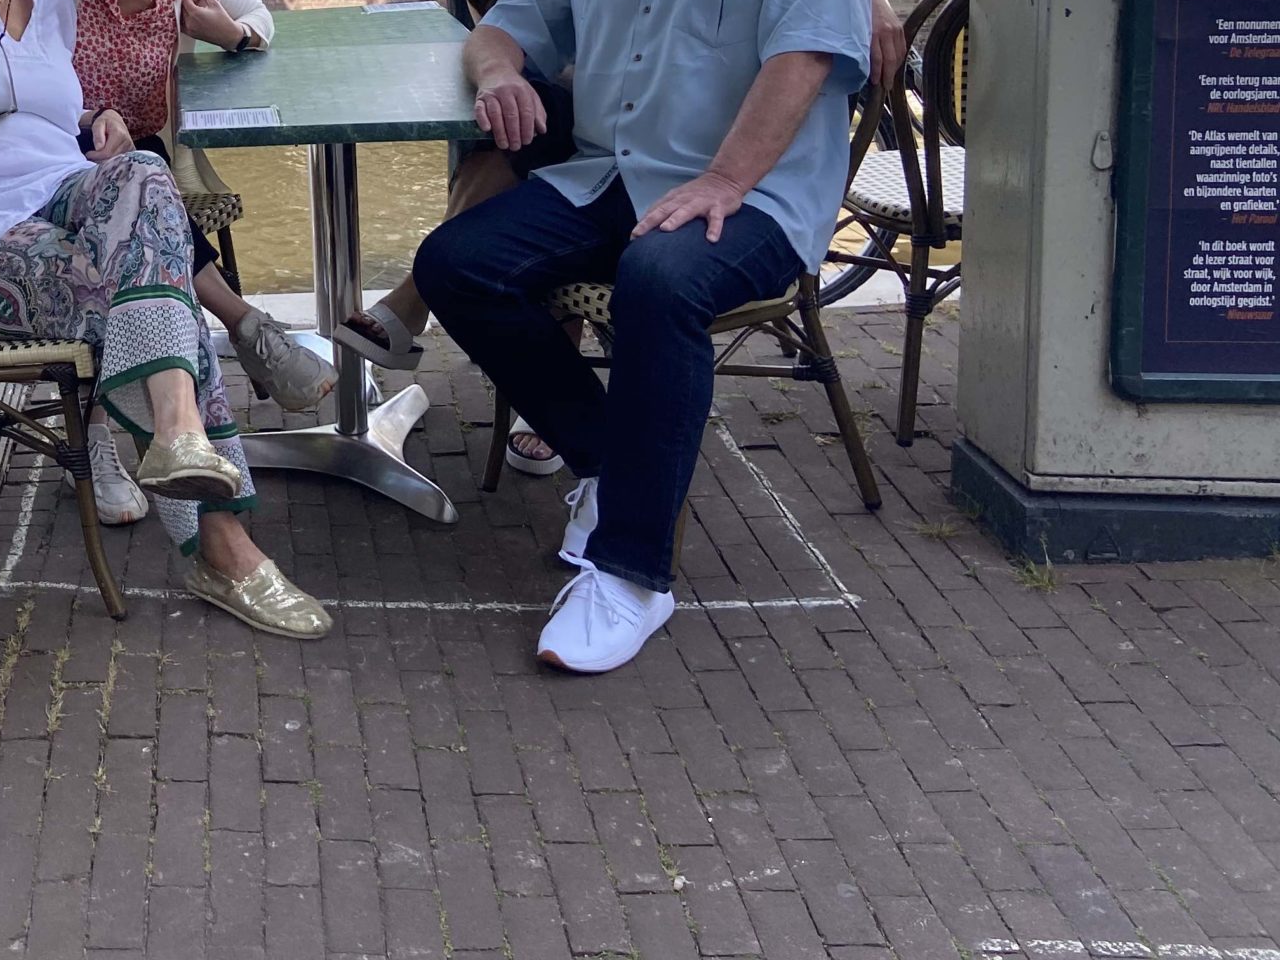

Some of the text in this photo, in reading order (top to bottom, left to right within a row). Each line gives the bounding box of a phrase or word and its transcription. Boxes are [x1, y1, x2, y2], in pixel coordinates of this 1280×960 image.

[1208, 35, 1229, 44] voor
[1218, 75, 1234, 86] reis
[1236, 75, 1260, 87] terug
[1210, 88, 1221, 100] de
[1204, 130, 1226, 141] Atlas
[1228, 130, 1260, 141] wemelt
[1262, 132, 1278, 141] van
[1189, 144, 1280, 157] aangrijpende details,
[1210, 158, 1277, 169] naast tientallen
[1196, 171, 1278, 184] waanzinnige foto's
[1183, 185, 1277, 198] en bijzondere kaarten
[1220, 201, 1231, 211] en
[1212, 240, 1224, 251] dit
[1225, 240, 1247, 251] boek
[1249, 240, 1275, 251] wordt
[1192, 254, 1275, 265] de lezer straat voor
[1183, 267, 1276, 280] straat, wijk voor wijk,
[1190, 281, 1273, 292] door Amsterdam in
[1189, 295, 1236, 308] oorlogstijd
